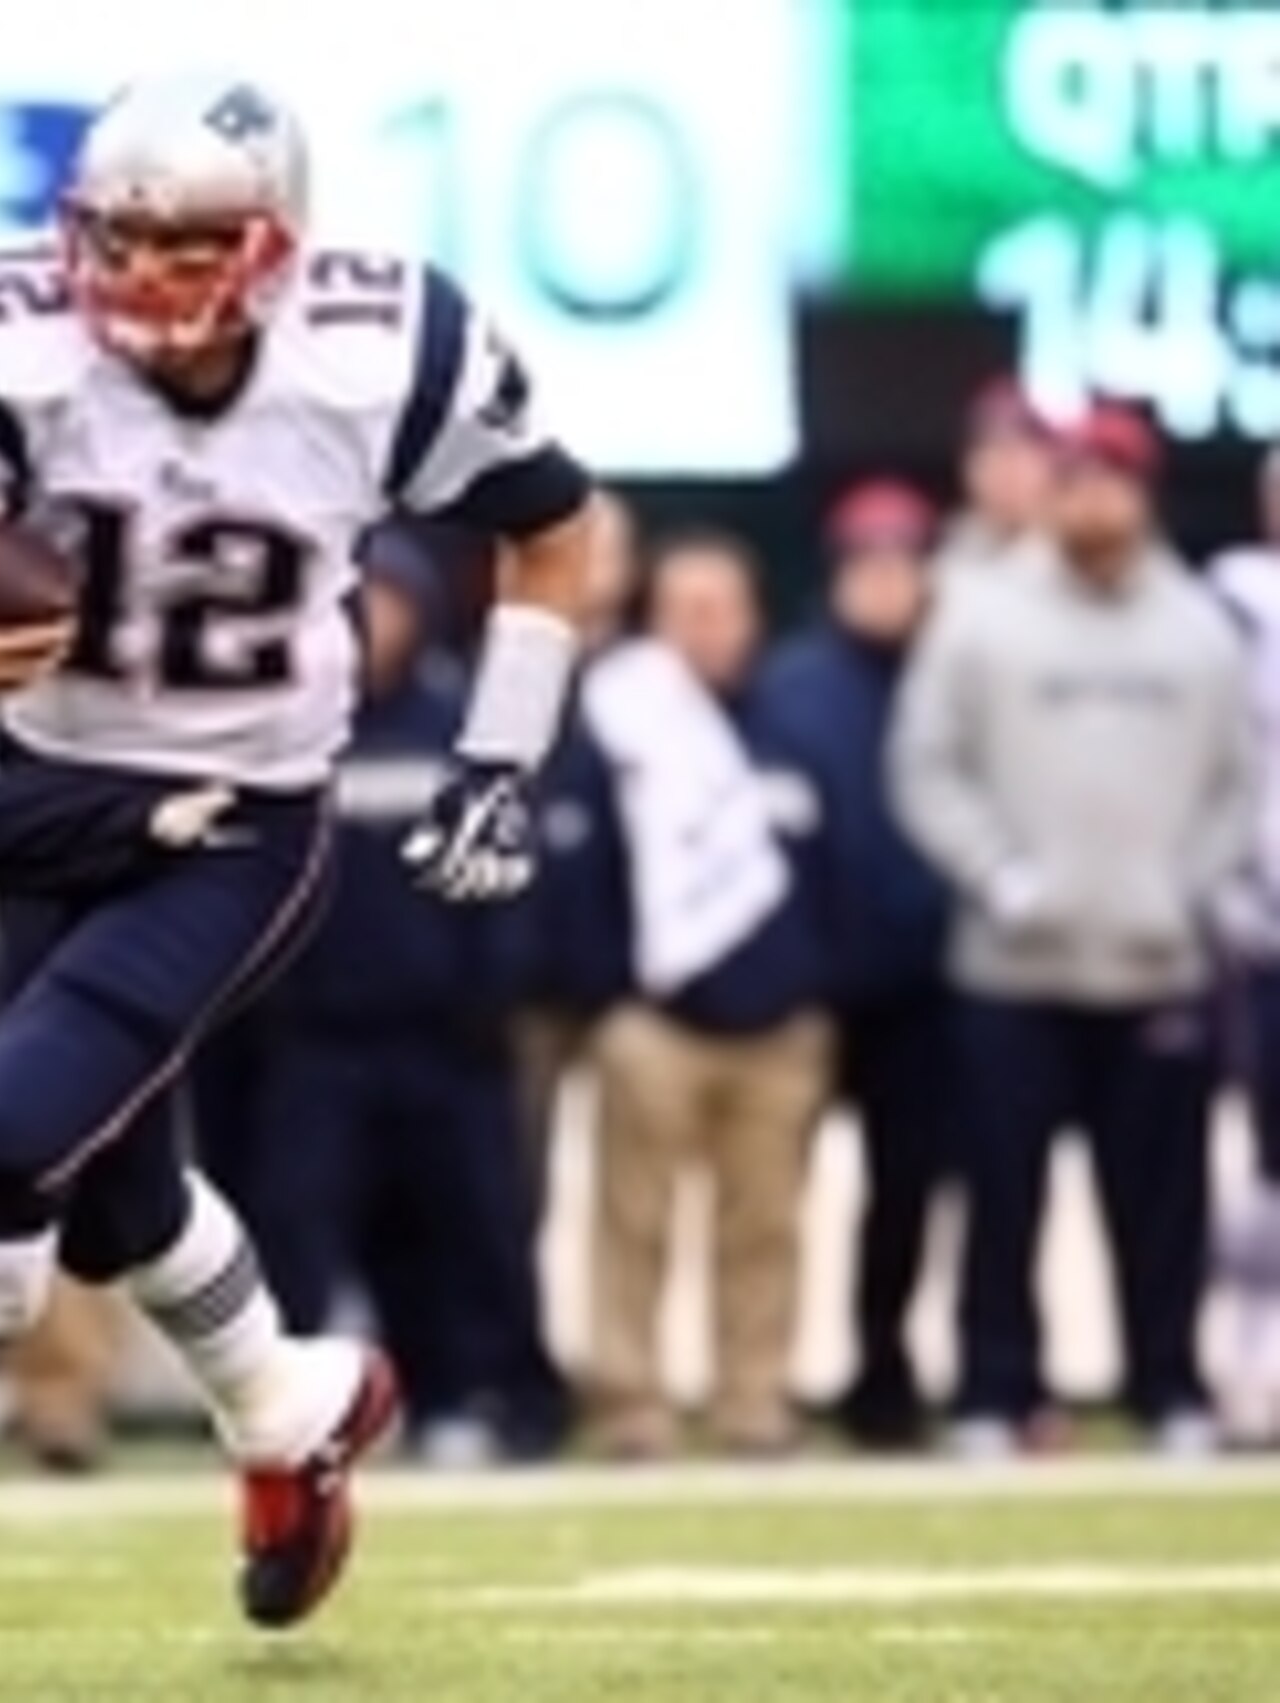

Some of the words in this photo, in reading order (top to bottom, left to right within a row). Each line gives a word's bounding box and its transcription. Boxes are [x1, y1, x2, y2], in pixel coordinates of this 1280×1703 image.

[305, 247, 404, 335] 12
[372, 92, 705, 326] 10
[48, 492, 320, 694] 12
